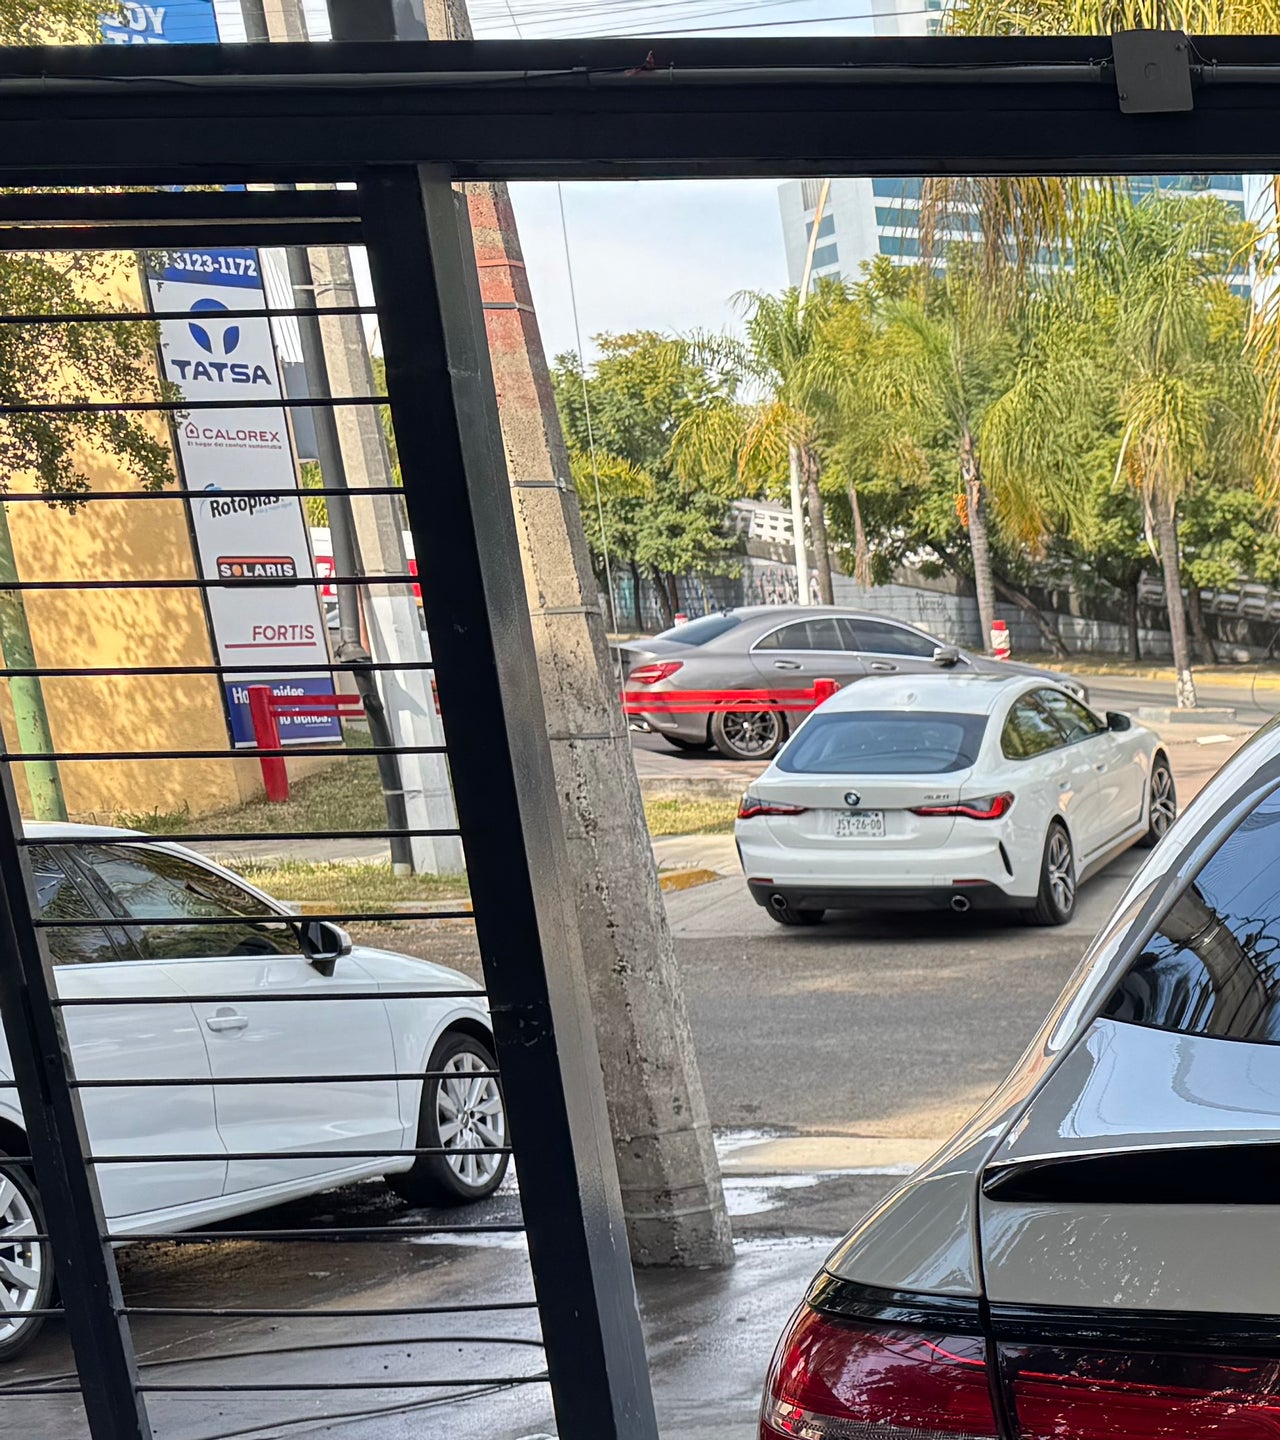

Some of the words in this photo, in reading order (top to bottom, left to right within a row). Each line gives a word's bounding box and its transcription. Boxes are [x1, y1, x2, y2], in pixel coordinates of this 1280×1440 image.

[170, 359, 272, 385] TATSA
[202, 428, 281, 443] CALOREX
[220, 564, 294, 577] SOLARIS
[252, 625, 315, 641] FORTIS
